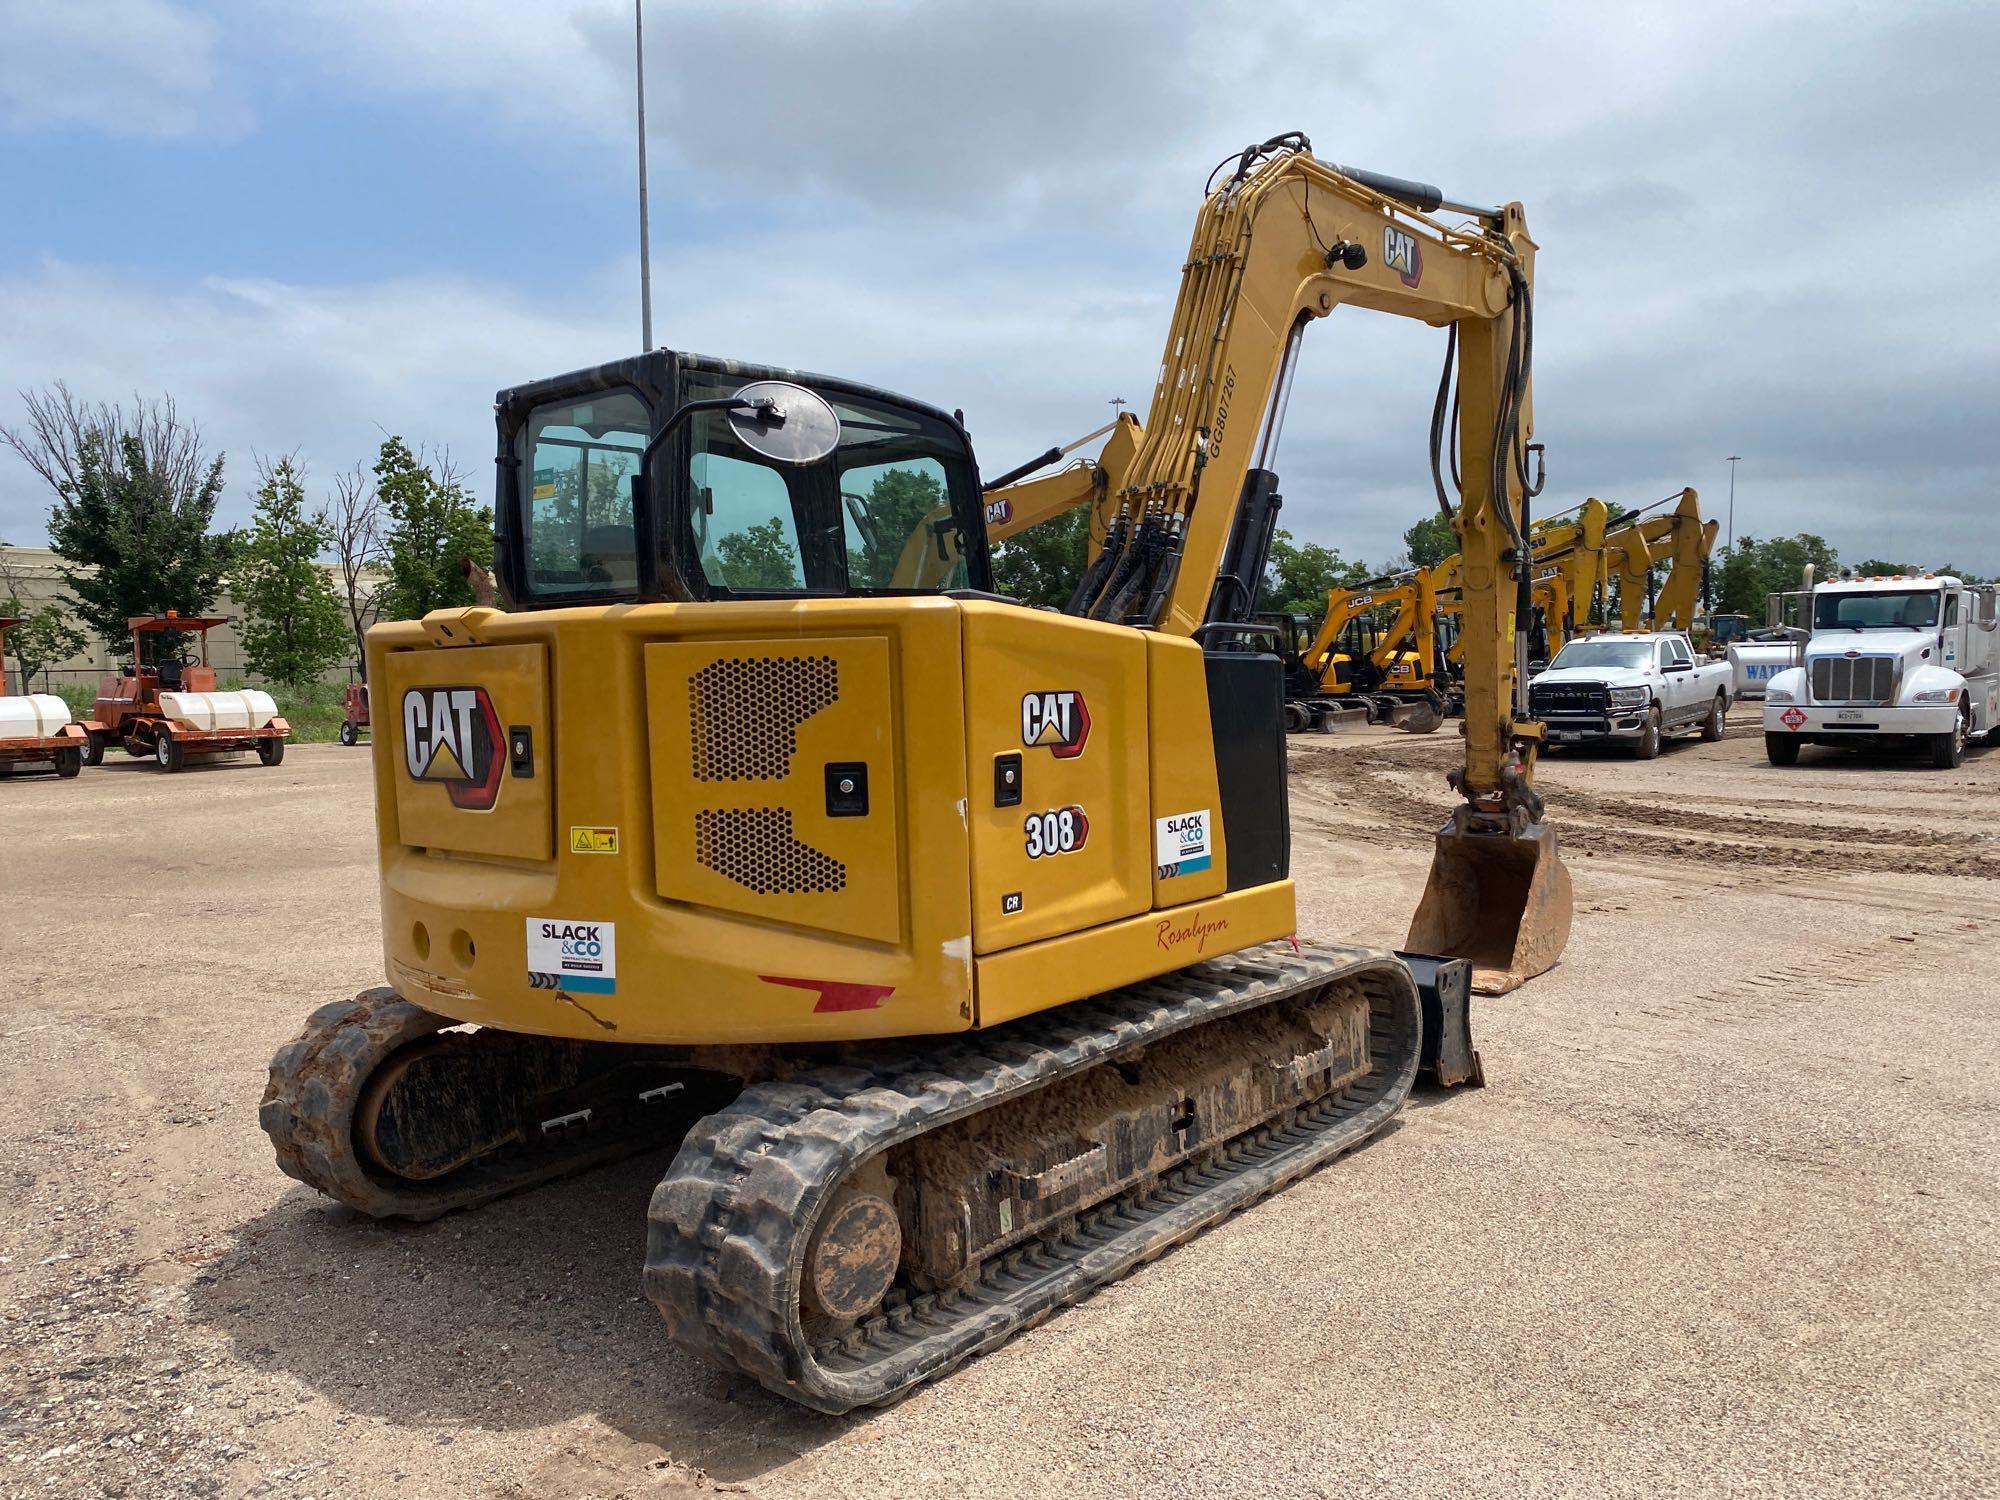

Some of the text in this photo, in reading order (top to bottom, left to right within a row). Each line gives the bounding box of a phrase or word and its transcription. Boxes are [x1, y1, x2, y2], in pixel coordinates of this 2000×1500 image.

[1384, 226, 1414, 275] CAT
[1211, 364, 1236, 458] GG807267
[986, 500, 1006, 523] CAT
[1348, 596, 1372, 608] JCB
[1391, 665, 1409, 673] CB
[1022, 692, 1074, 745] CAT
[404, 690, 476, 779] CAT
[1026, 810, 1074, 857] 308
[1167, 815, 1202, 834] SLACK
[1180, 828, 1203, 843] &CO
[1006, 896, 1019, 910] CR
[542, 924, 600, 941] SLACK
[1156, 912, 1228, 953] Rosalynn
[561, 940, 601, 956] &CO
